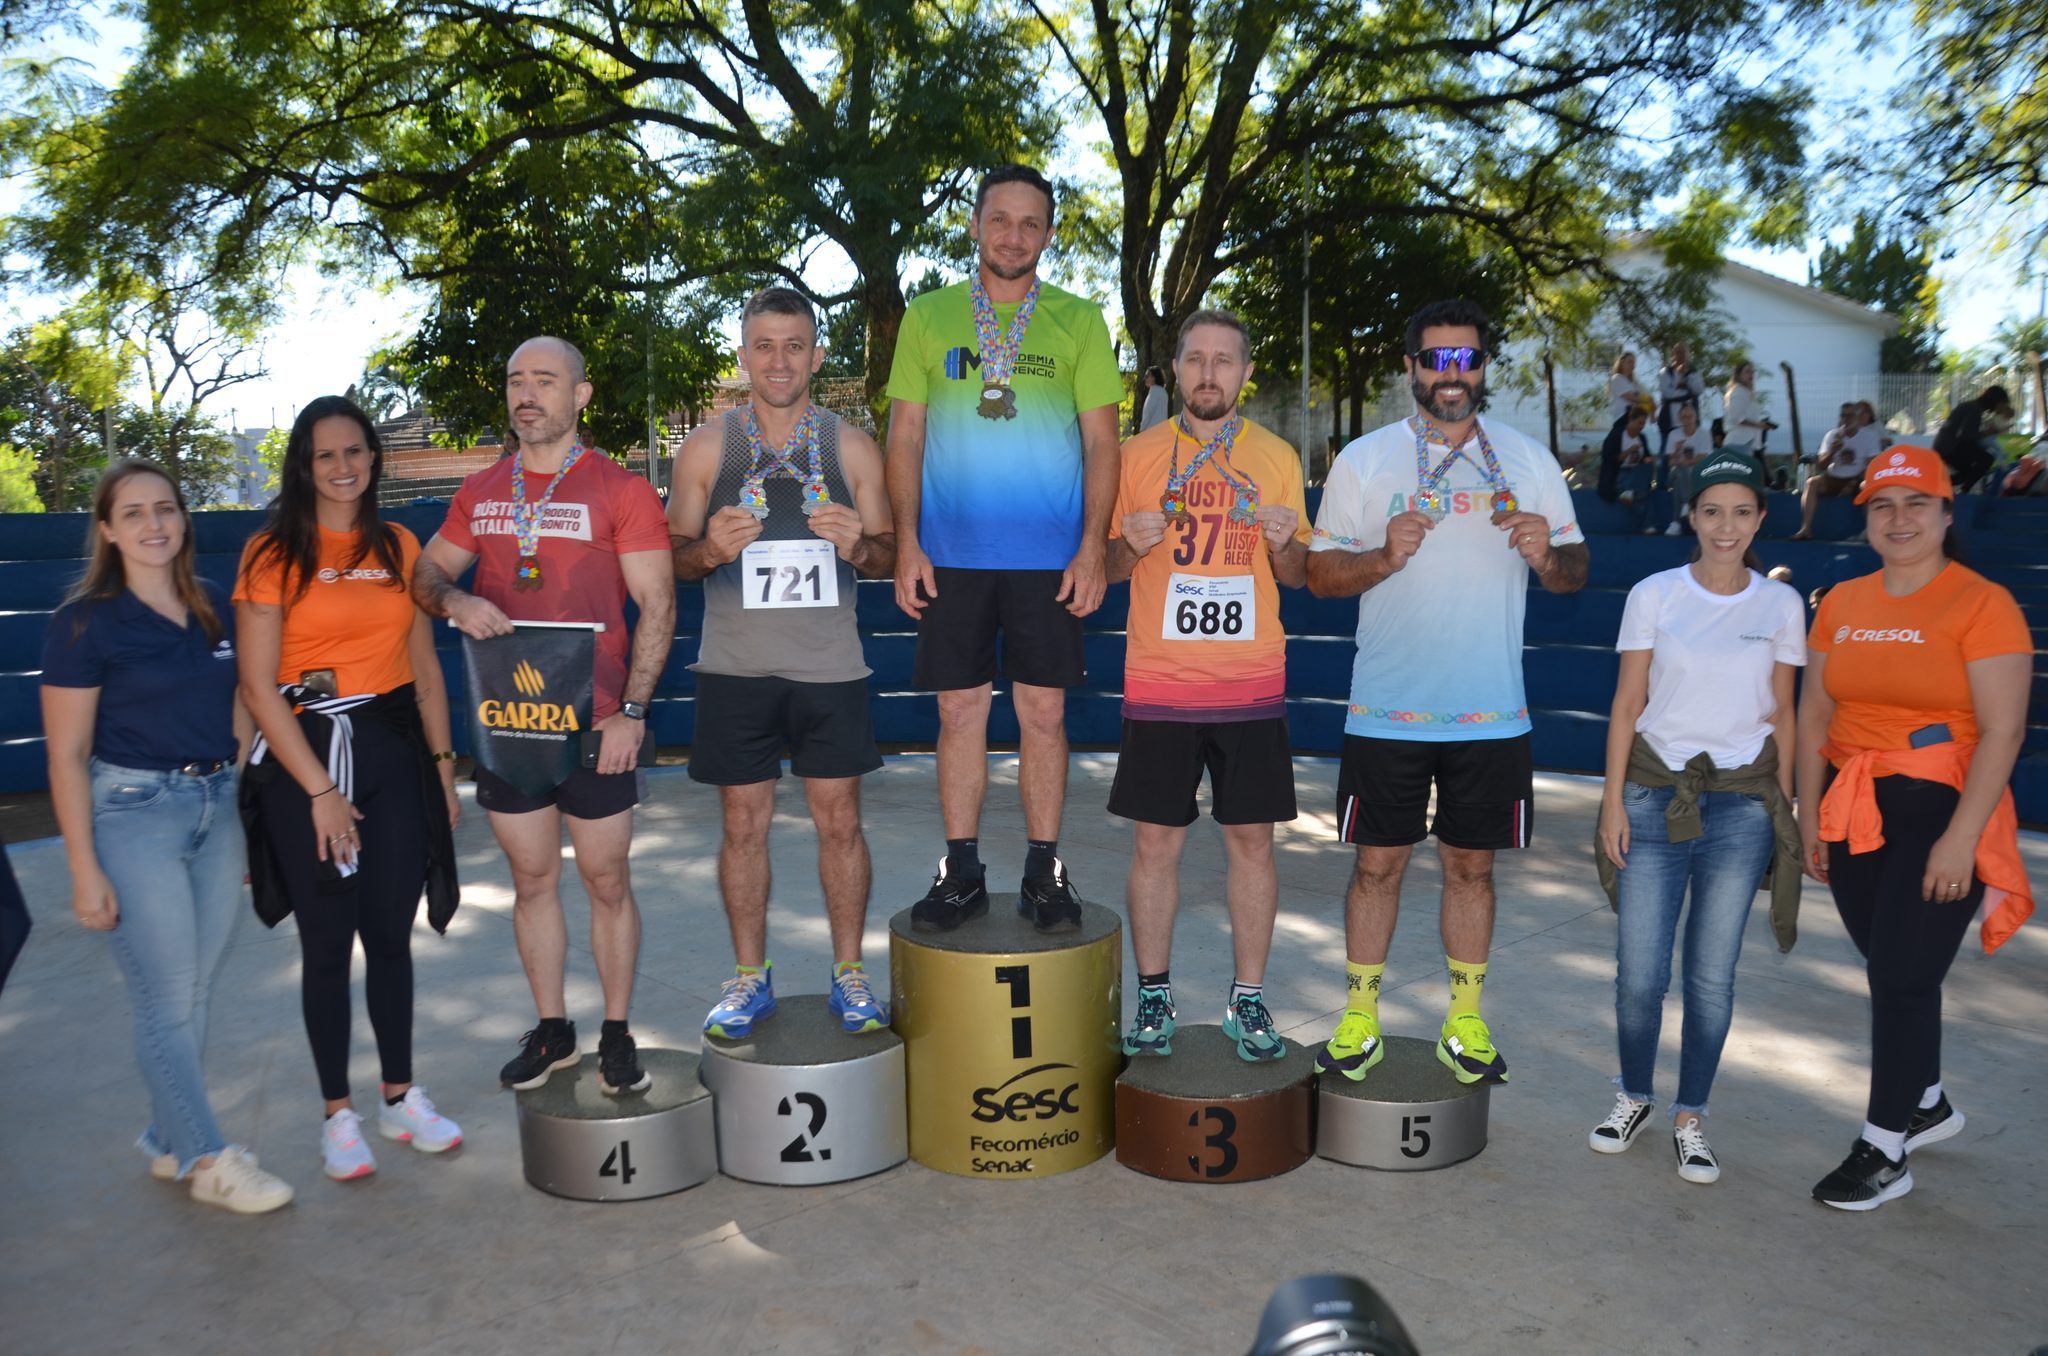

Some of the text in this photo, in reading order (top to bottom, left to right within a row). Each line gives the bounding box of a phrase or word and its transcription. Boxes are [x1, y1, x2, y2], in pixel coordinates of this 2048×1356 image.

[1018, 353, 1055, 366] DEMIA
[1874, 467, 1922, 480] CRESOL
[1173, 514, 1223, 566] 37
[756, 565, 821, 603] 721
[1175, 583, 1205, 596] Sesc
[1176, 600, 1243, 635] 688
[1851, 628, 1926, 644] CRESOL
[478, 699, 579, 732] GARRA
[995, 964, 1032, 1059] 1
[971, 1083, 1080, 1123] Sesc
[778, 1092, 831, 1162] 2
[970, 1128, 1080, 1153] Fecomércio
[1188, 1106, 1238, 1177] 3
[1400, 1115, 1431, 1158] 5
[599, 1140, 637, 1184] 4
[971, 1157, 1033, 1174] Senac
